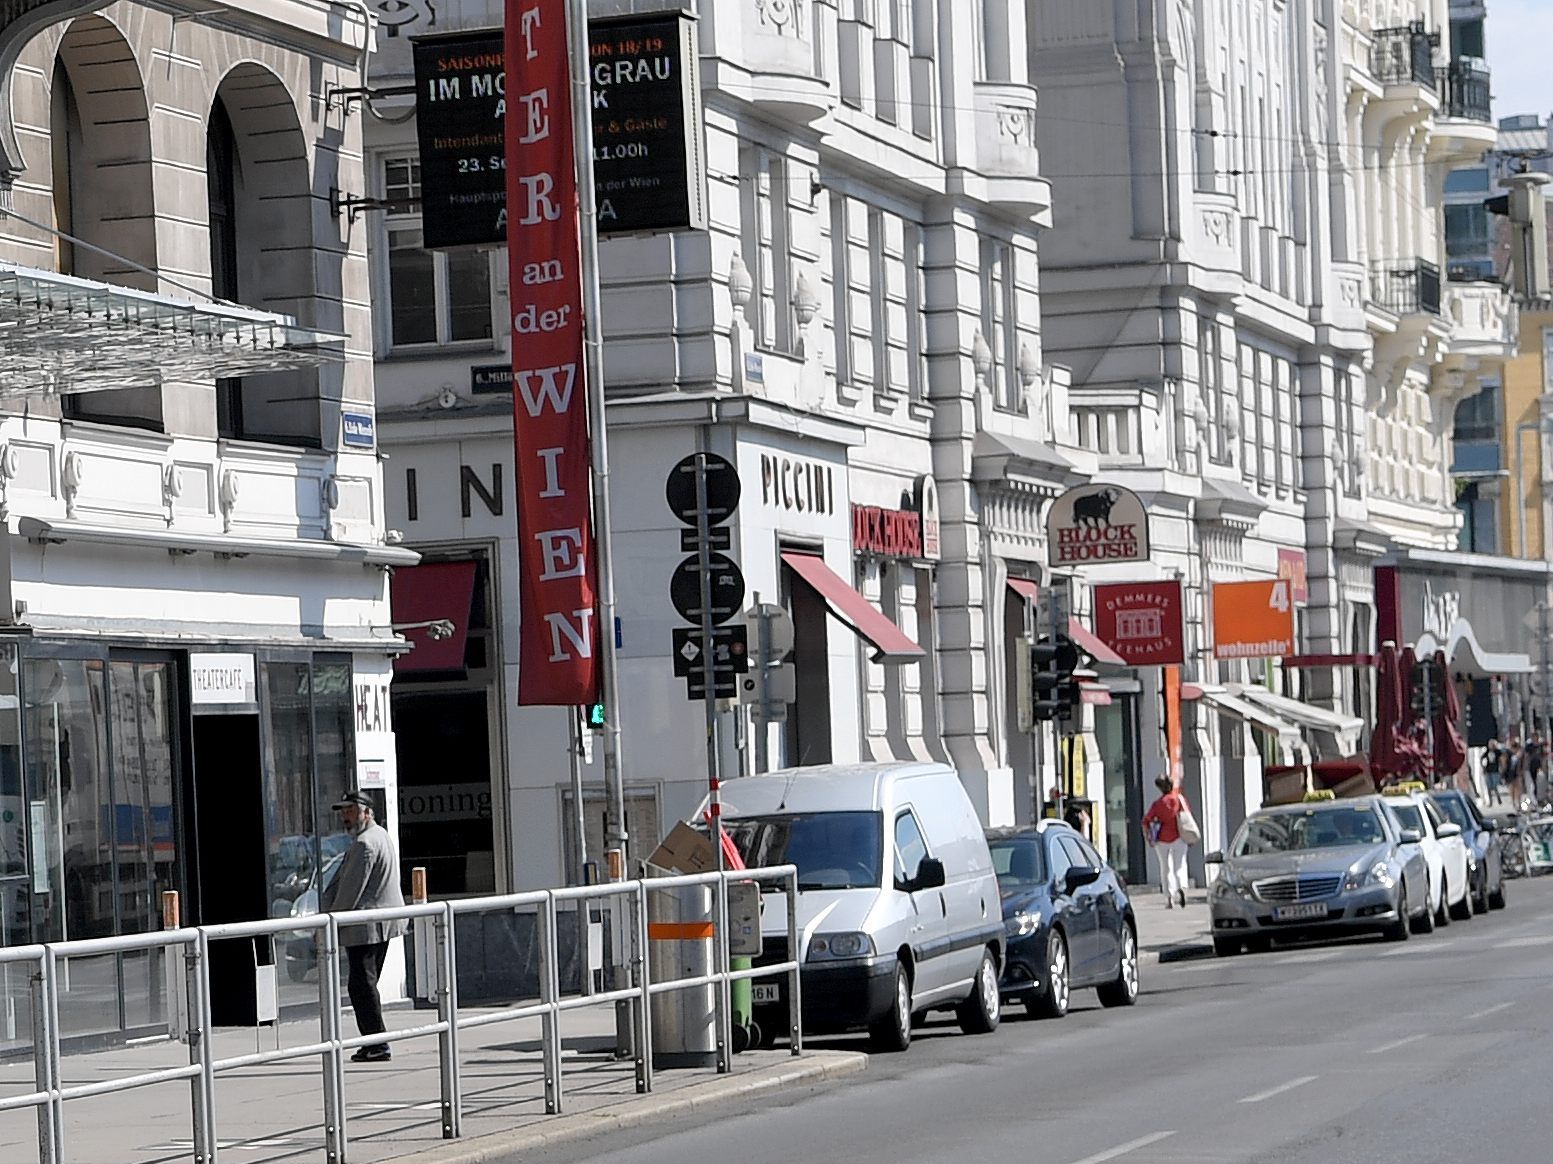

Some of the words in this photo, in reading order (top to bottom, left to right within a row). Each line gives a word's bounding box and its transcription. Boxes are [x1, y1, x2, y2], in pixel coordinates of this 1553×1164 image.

[428, 76, 461, 102] IM
[457, 158, 486, 173] 23.
[521, 258, 565, 286] an
[514, 304, 571, 335] der
[761, 453, 834, 516] PICCINI
[512, 363, 594, 663] WIEN
[1057, 522, 1137, 544] BLOCK
[1057, 541, 1138, 561] HOUSE
[1268, 581, 1290, 613] 4
